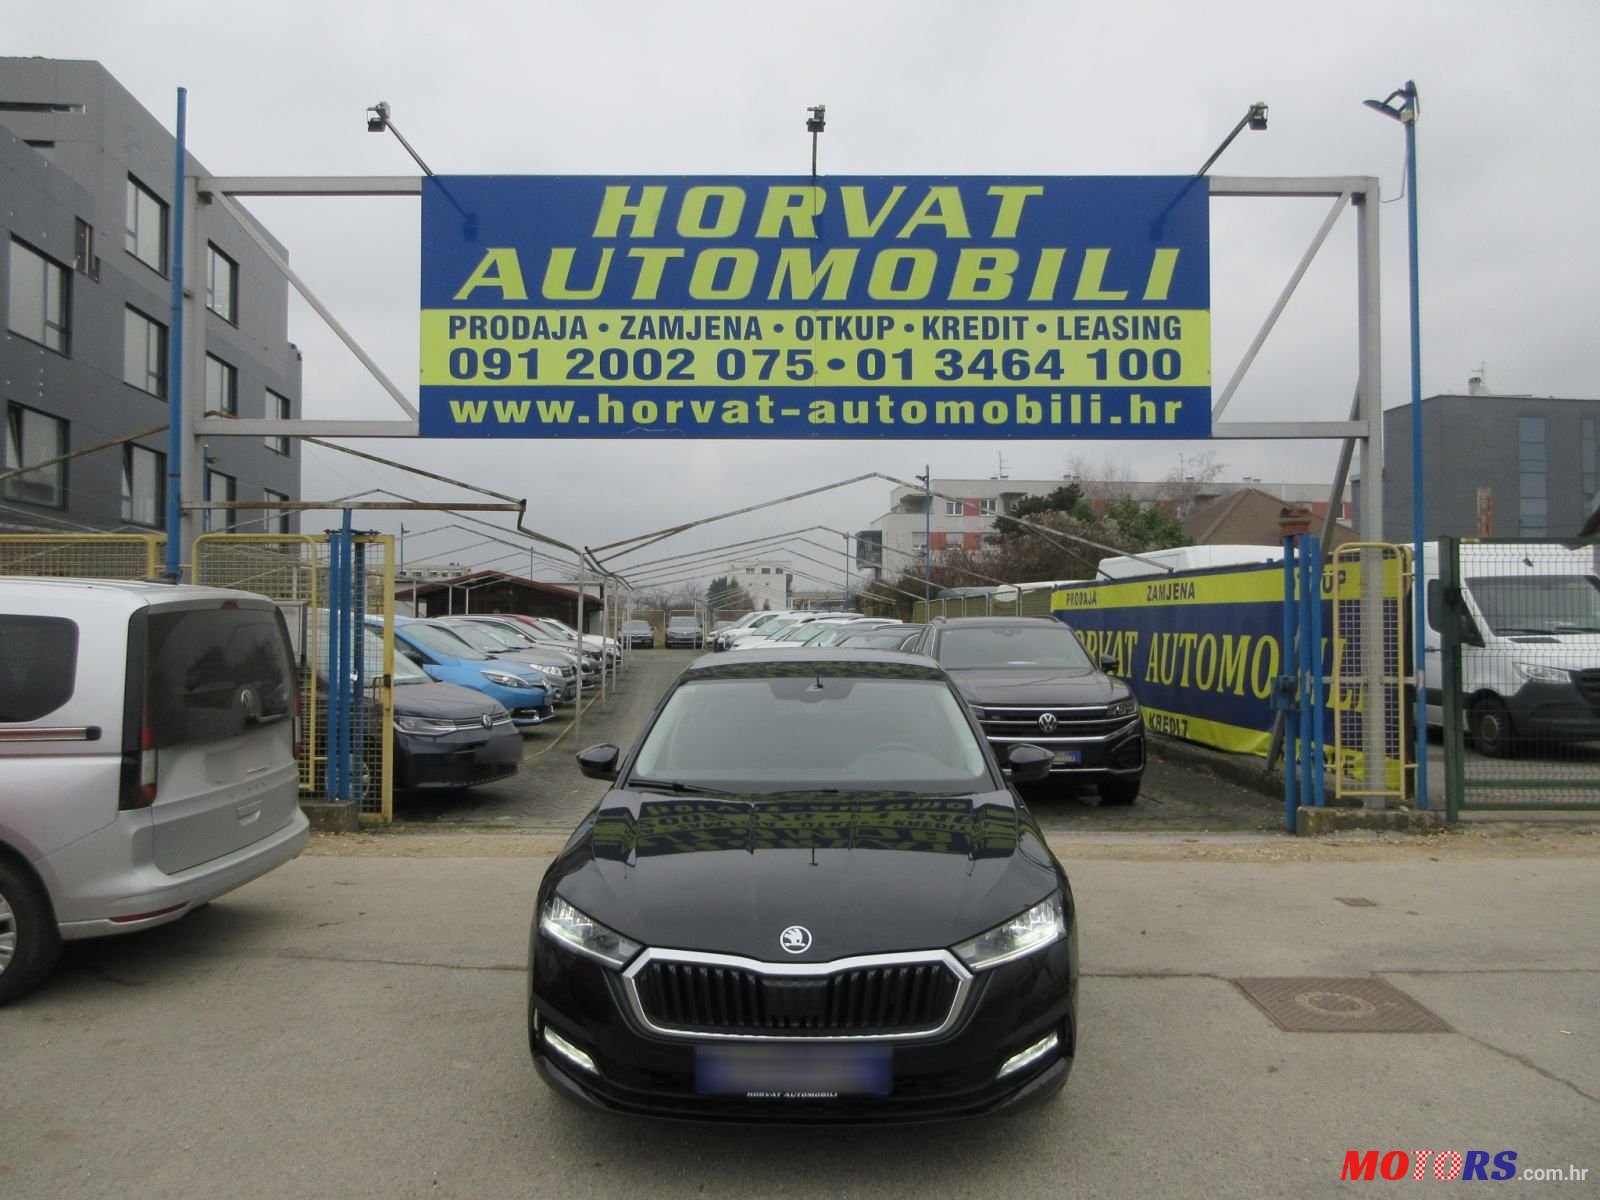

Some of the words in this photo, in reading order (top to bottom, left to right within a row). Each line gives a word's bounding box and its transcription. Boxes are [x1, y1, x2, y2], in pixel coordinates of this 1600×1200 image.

[592, 185, 1044, 239] HORVAT
[453, 247, 1181, 301] AUTOMOBILI
[448, 315, 588, 341] PRODAJA
[619, 315, 763, 341] ZAMJENA
[794, 315, 895, 341] OTKUP
[922, 315, 1029, 341] KREDIT
[1056, 315, 1182, 341] LEASING
[448, 347, 540, 381] 091
[565, 348, 696, 381] 2002
[716, 348, 815, 381] 075
[856, 348, 913, 381] 01
[934, 348, 1065, 381] 3464
[1086, 348, 1182, 381] 100
[448, 393, 1183, 425] www.horvat-automobili.hr
[1065, 590, 1097, 606] PRODAJA
[1146, 582, 1196, 602] ZAMJENA
